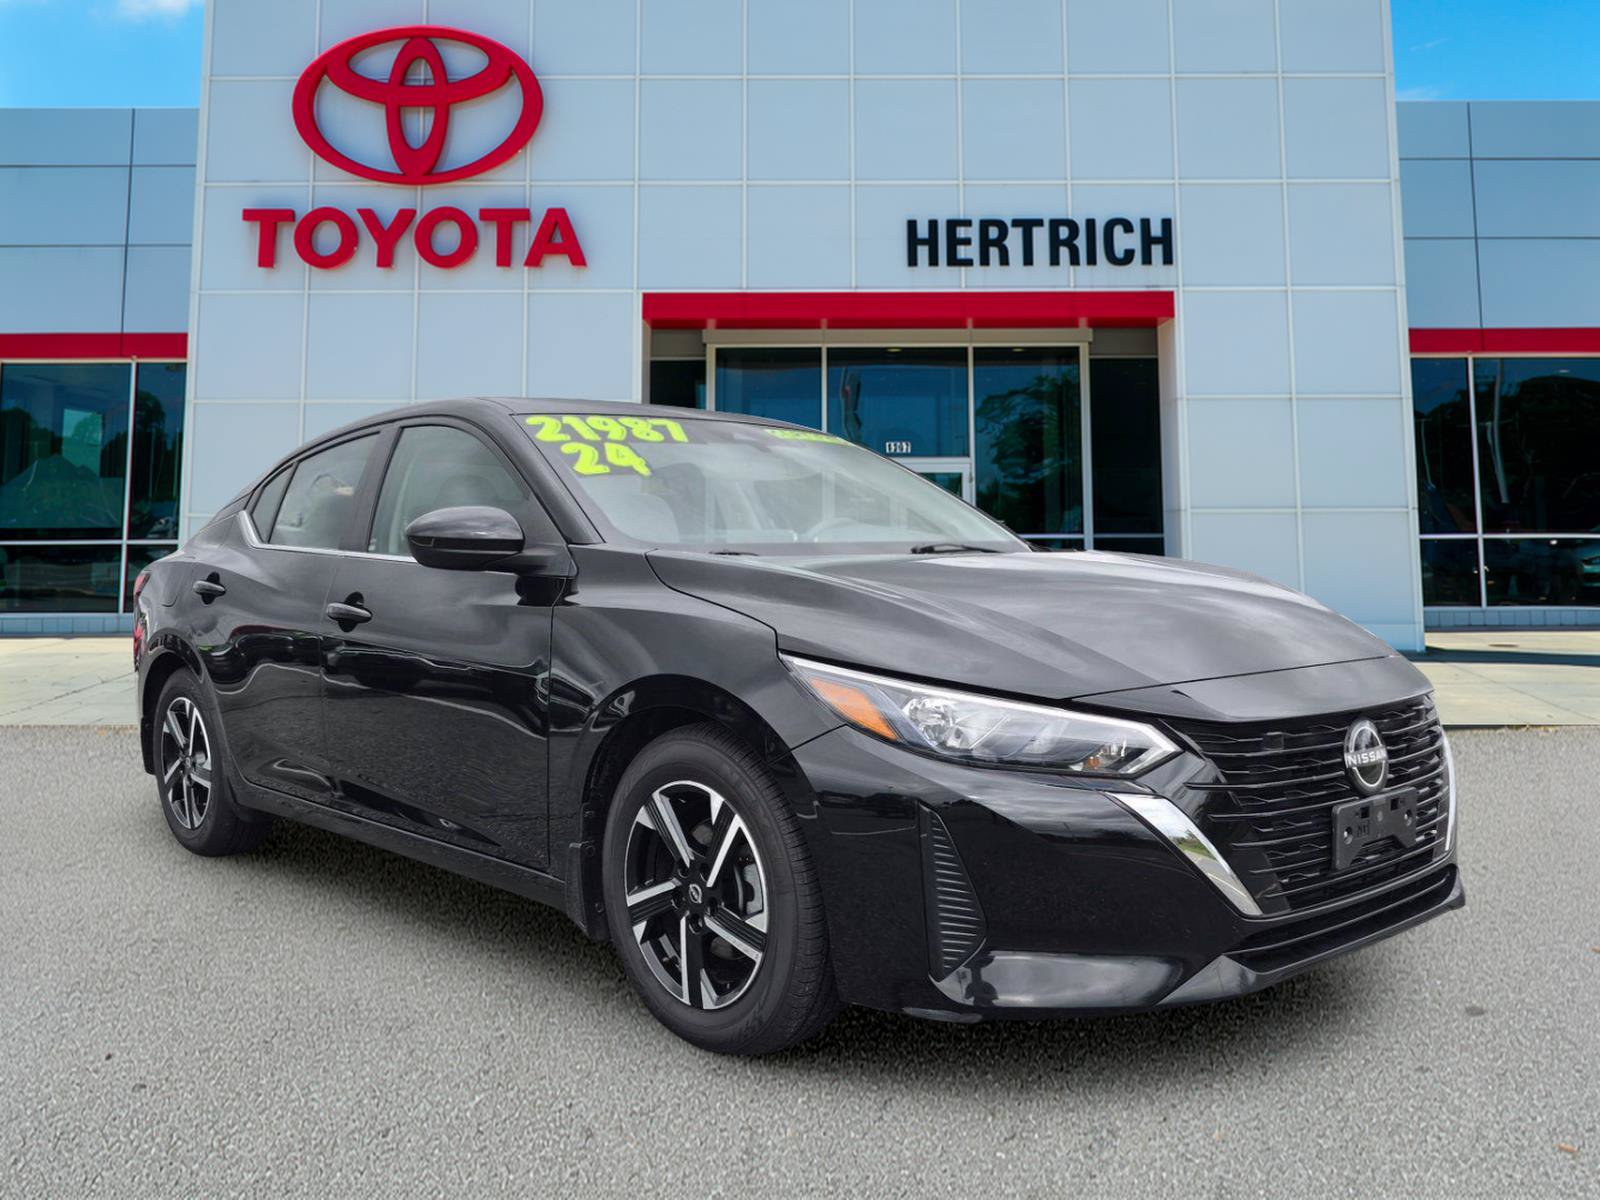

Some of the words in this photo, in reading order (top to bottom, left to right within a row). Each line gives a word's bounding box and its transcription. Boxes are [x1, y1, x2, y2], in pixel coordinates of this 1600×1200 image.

[242, 206, 587, 269] TOYOTA
[906, 218, 1174, 267] HERTRICH
[526, 415, 688, 442] 21987
[560, 442, 652, 477] 24
[1347, 748, 1387, 767] NISSAN
